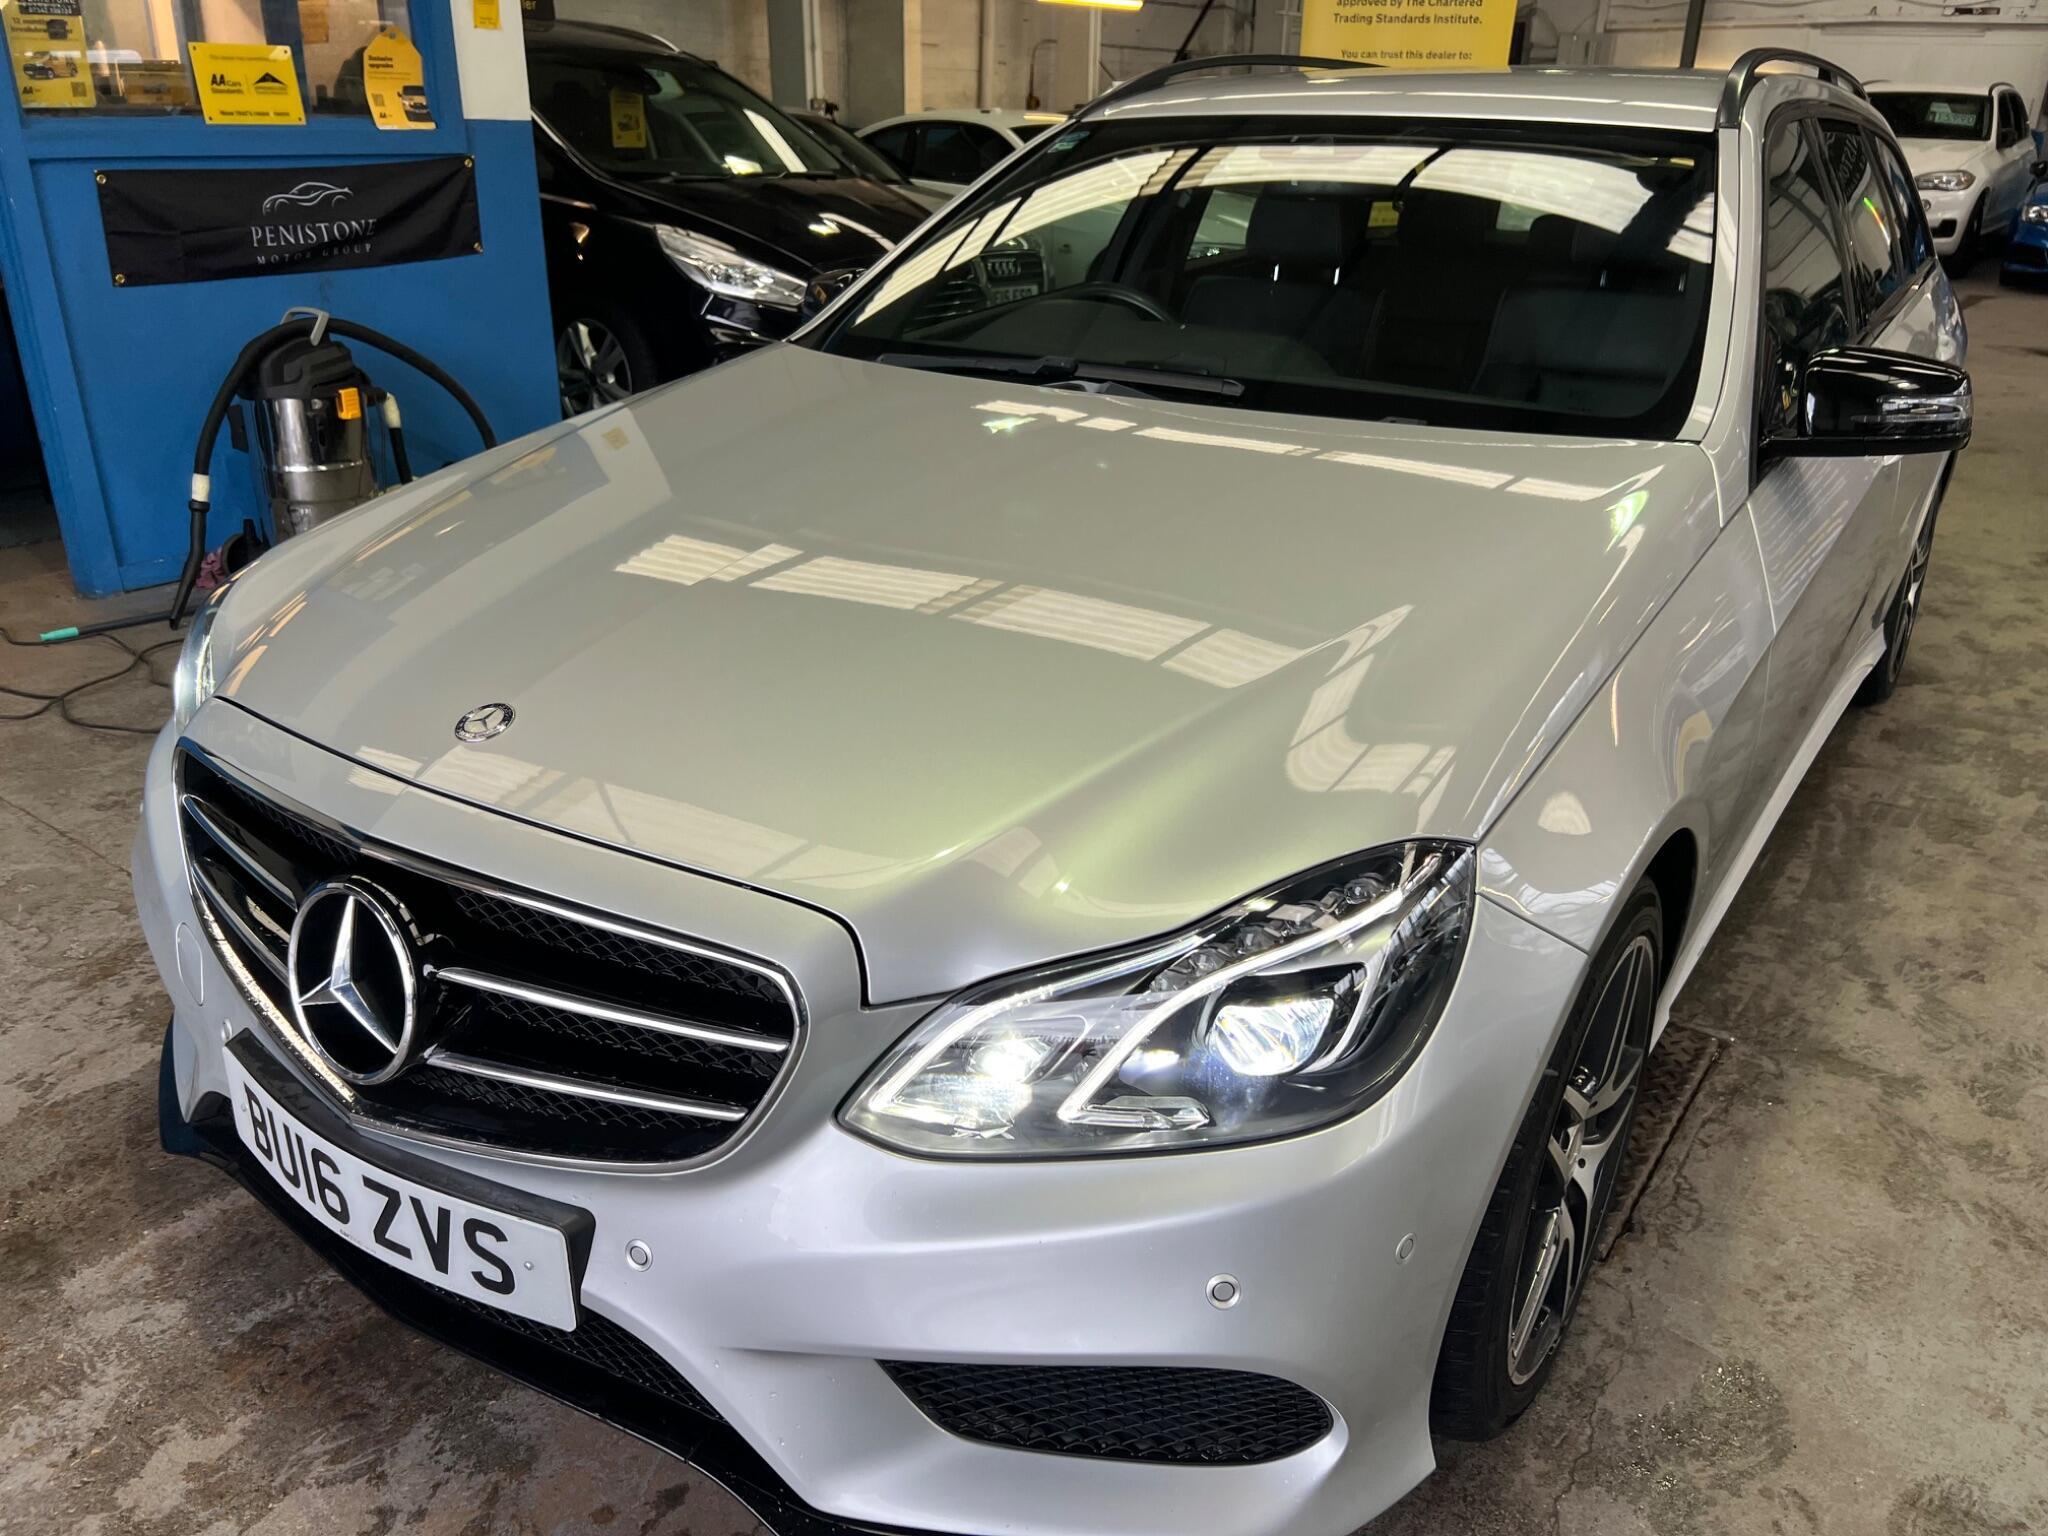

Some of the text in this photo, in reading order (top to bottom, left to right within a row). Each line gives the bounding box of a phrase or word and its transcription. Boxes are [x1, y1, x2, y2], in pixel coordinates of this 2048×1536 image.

[1336, 0, 1388, 8] approved
[1391, 0, 1402, 9] by
[1334, 13, 1484, 25] Trading Standards Institute.
[1341, 50, 1472, 60] You can trust this dealer to:
[210, 74, 226, 86] AA
[250, 218, 377, 248] PENISTONE
[244, 1082, 516, 1296] BU16 ZVS
